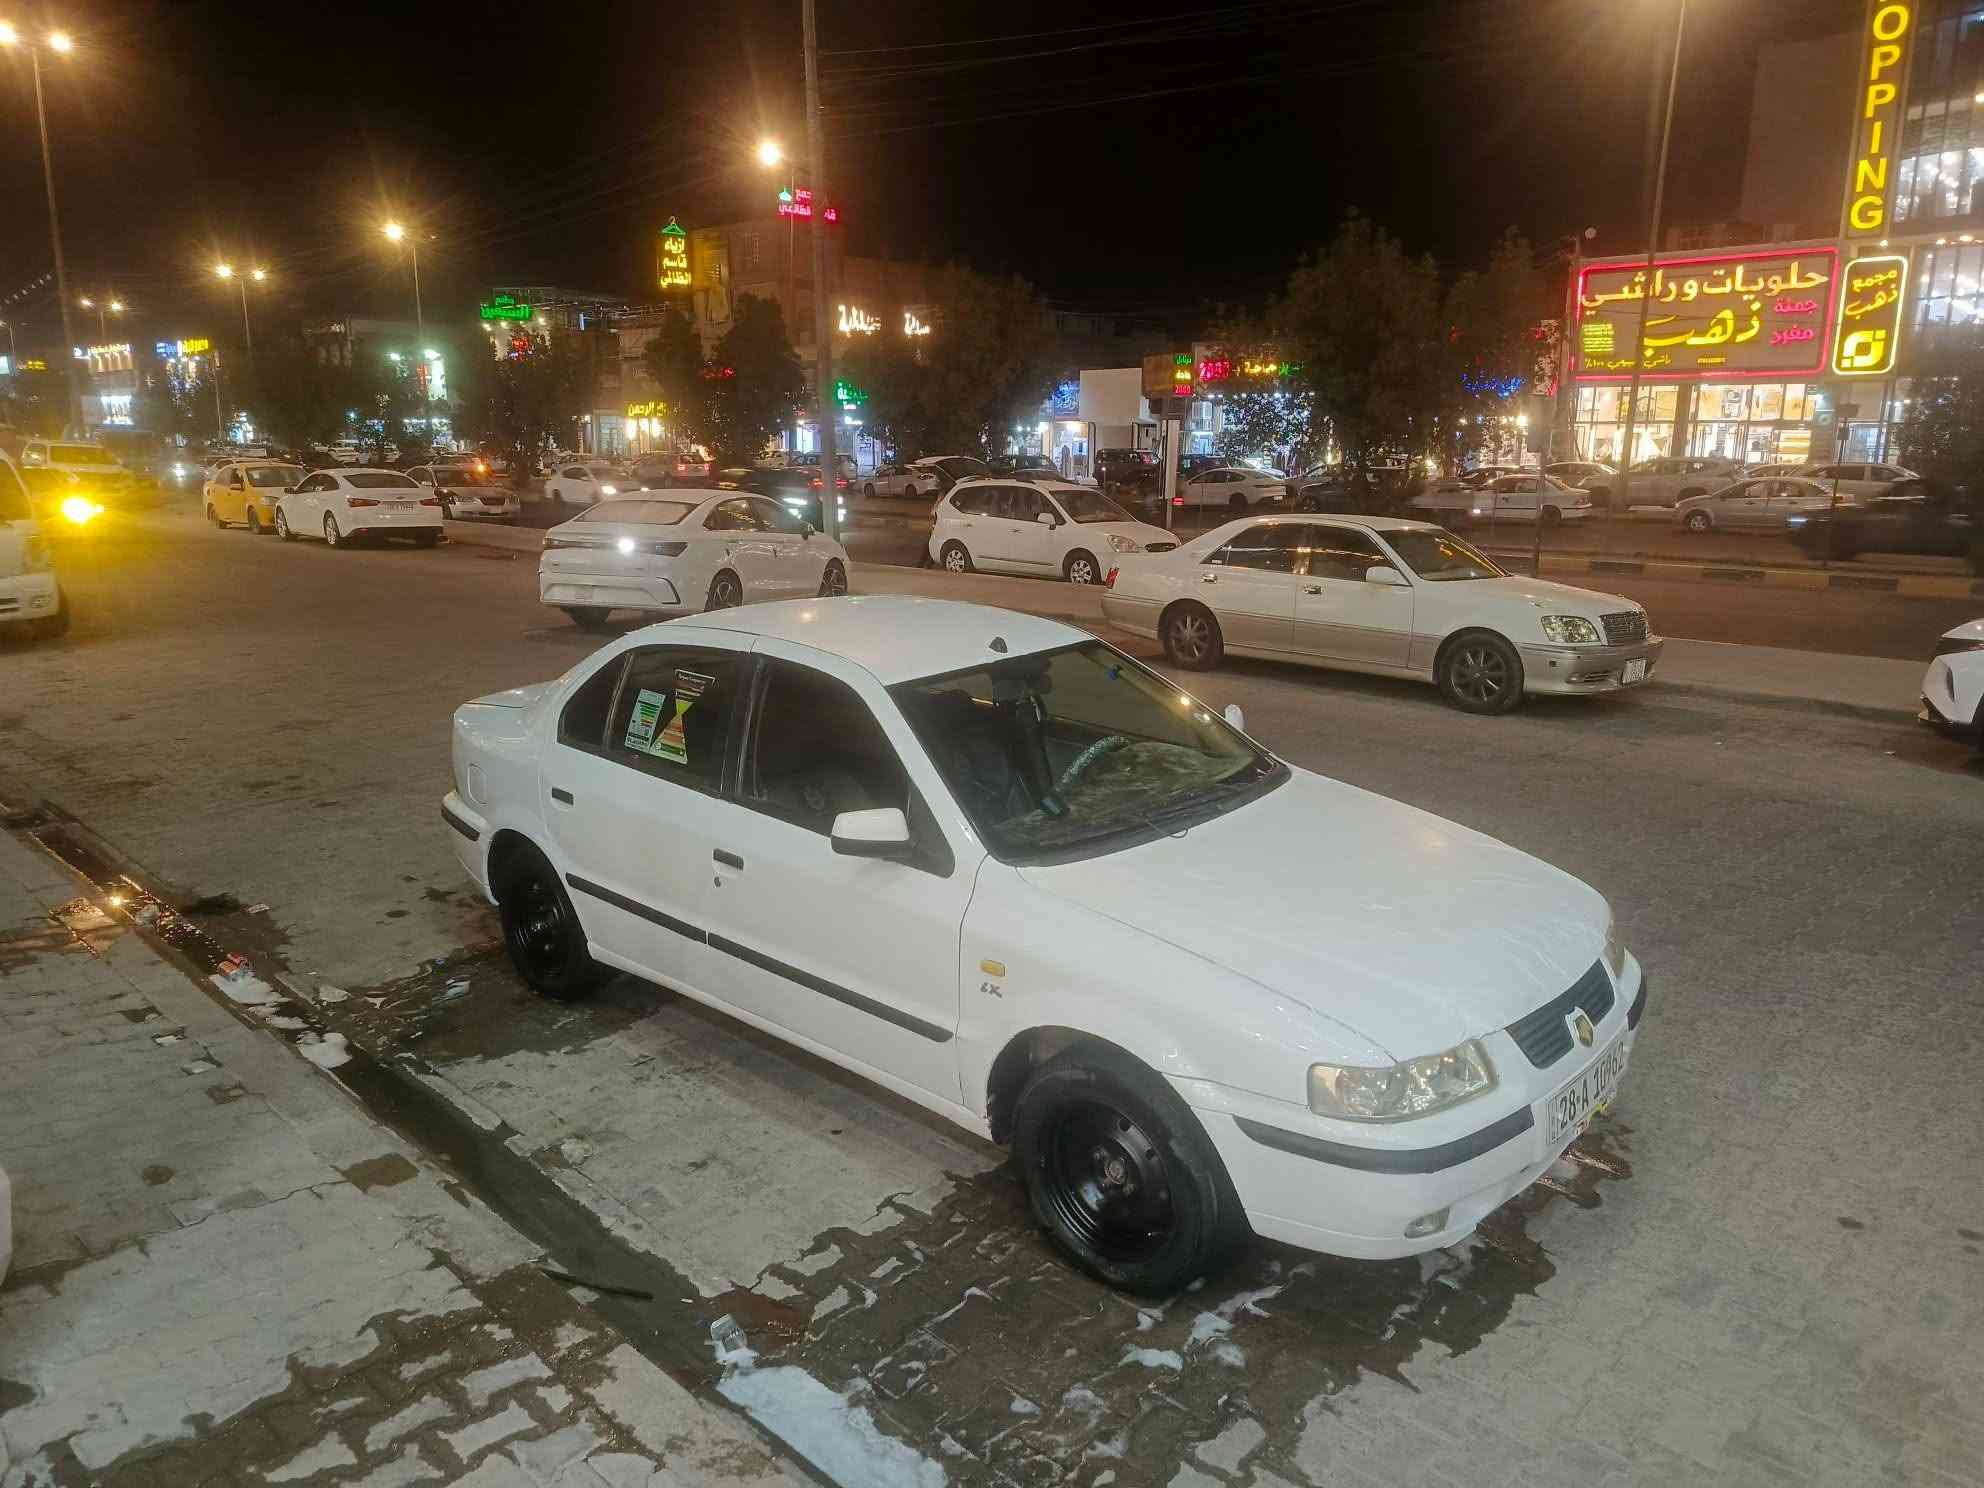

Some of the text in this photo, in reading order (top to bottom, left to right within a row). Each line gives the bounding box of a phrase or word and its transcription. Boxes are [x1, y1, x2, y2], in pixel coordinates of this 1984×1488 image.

[1850, 0, 1909, 229] OPPING
[1702, 261, 1830, 301] حلويات
[1852, 269, 1898, 293] مجمع
[1845, 283, 1899, 320] ذهب
[1642, 300, 1762, 358] ذهب
